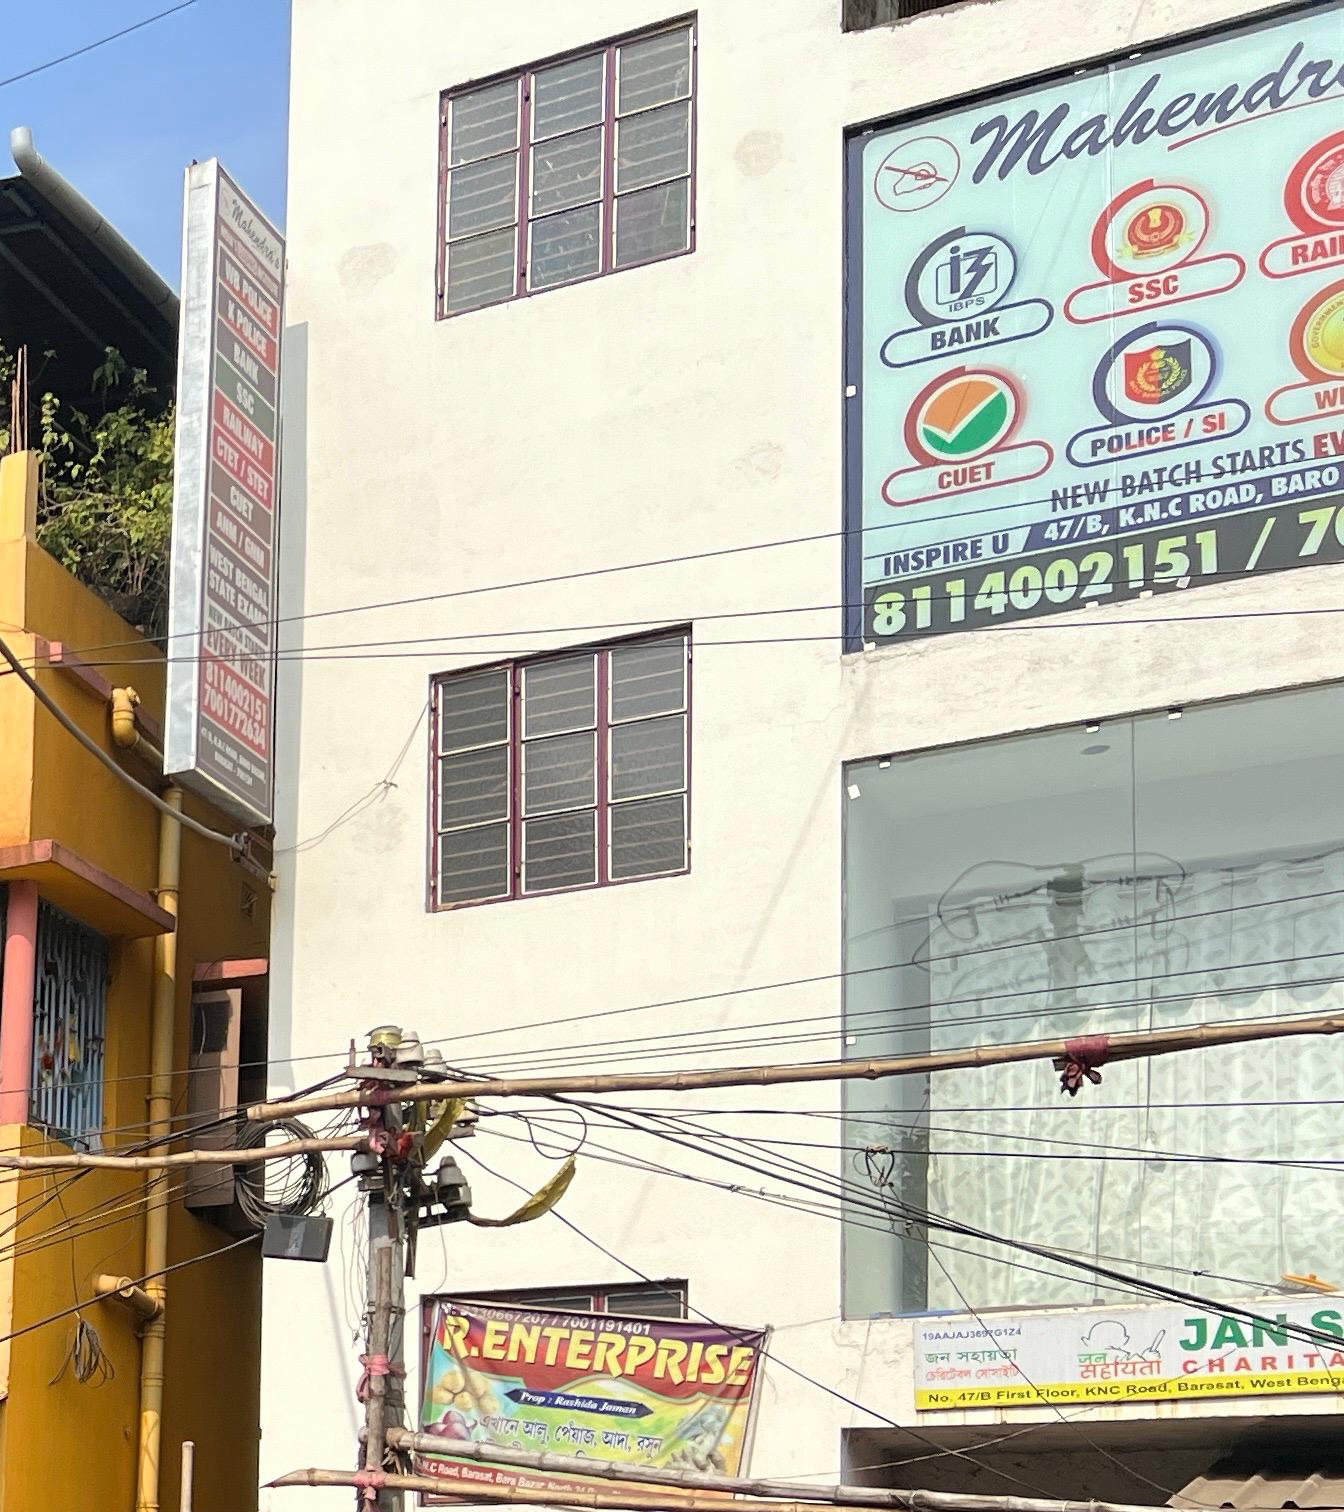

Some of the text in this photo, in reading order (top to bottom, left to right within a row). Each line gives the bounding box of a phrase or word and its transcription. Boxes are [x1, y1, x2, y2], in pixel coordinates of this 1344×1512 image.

[242, 277, 272, 327] POLICE
[947, 297, 986, 313] IBPS
[1128, 274, 1179, 304] SSC
[236, 307, 267, 358] POLICE
[930, 317, 1001, 351] BANK
[233, 340, 258, 385] BANK
[236, 380, 254, 417] SSC
[222, 404, 263, 462] RAILWAY
[1091, 411, 1226, 457] POLICE / SI
[216, 434, 239, 475] CTET
[246, 464, 268, 502] STET
[938, 461, 996, 489] CUET
[1050, 478, 1111, 513] NEW
[1120, 459, 1203, 499] BATCH
[1210, 438, 1306, 480] STARTS
[229, 483, 253, 525] CUET
[883, 466, 1340, 577] INSPIRE U 47/B, K.N.C ROAD, BARO
[209, 543, 268, 613] WEST BENGAL
[209, 568, 235, 609] STATE
[873, 529, 1219, 636] 8114002151
[1245, 517, 1278, 571] /
[562, 1318, 651, 1335] 7001191401
[1179, 1313, 1288, 1351] JAN
[443, 1314, 755, 1387] R.ENTERPRISE
[1078, 1351, 1108, 1365] जन
[520, 1391, 545, 1406] Prop
[554, 1395, 599, 1412] Rashida
[600, 1402, 637, 1416] Jaman
[928, 1375, 1344, 1403] No. 47/B First Floor, KNC Road, Barasat, West Beng
